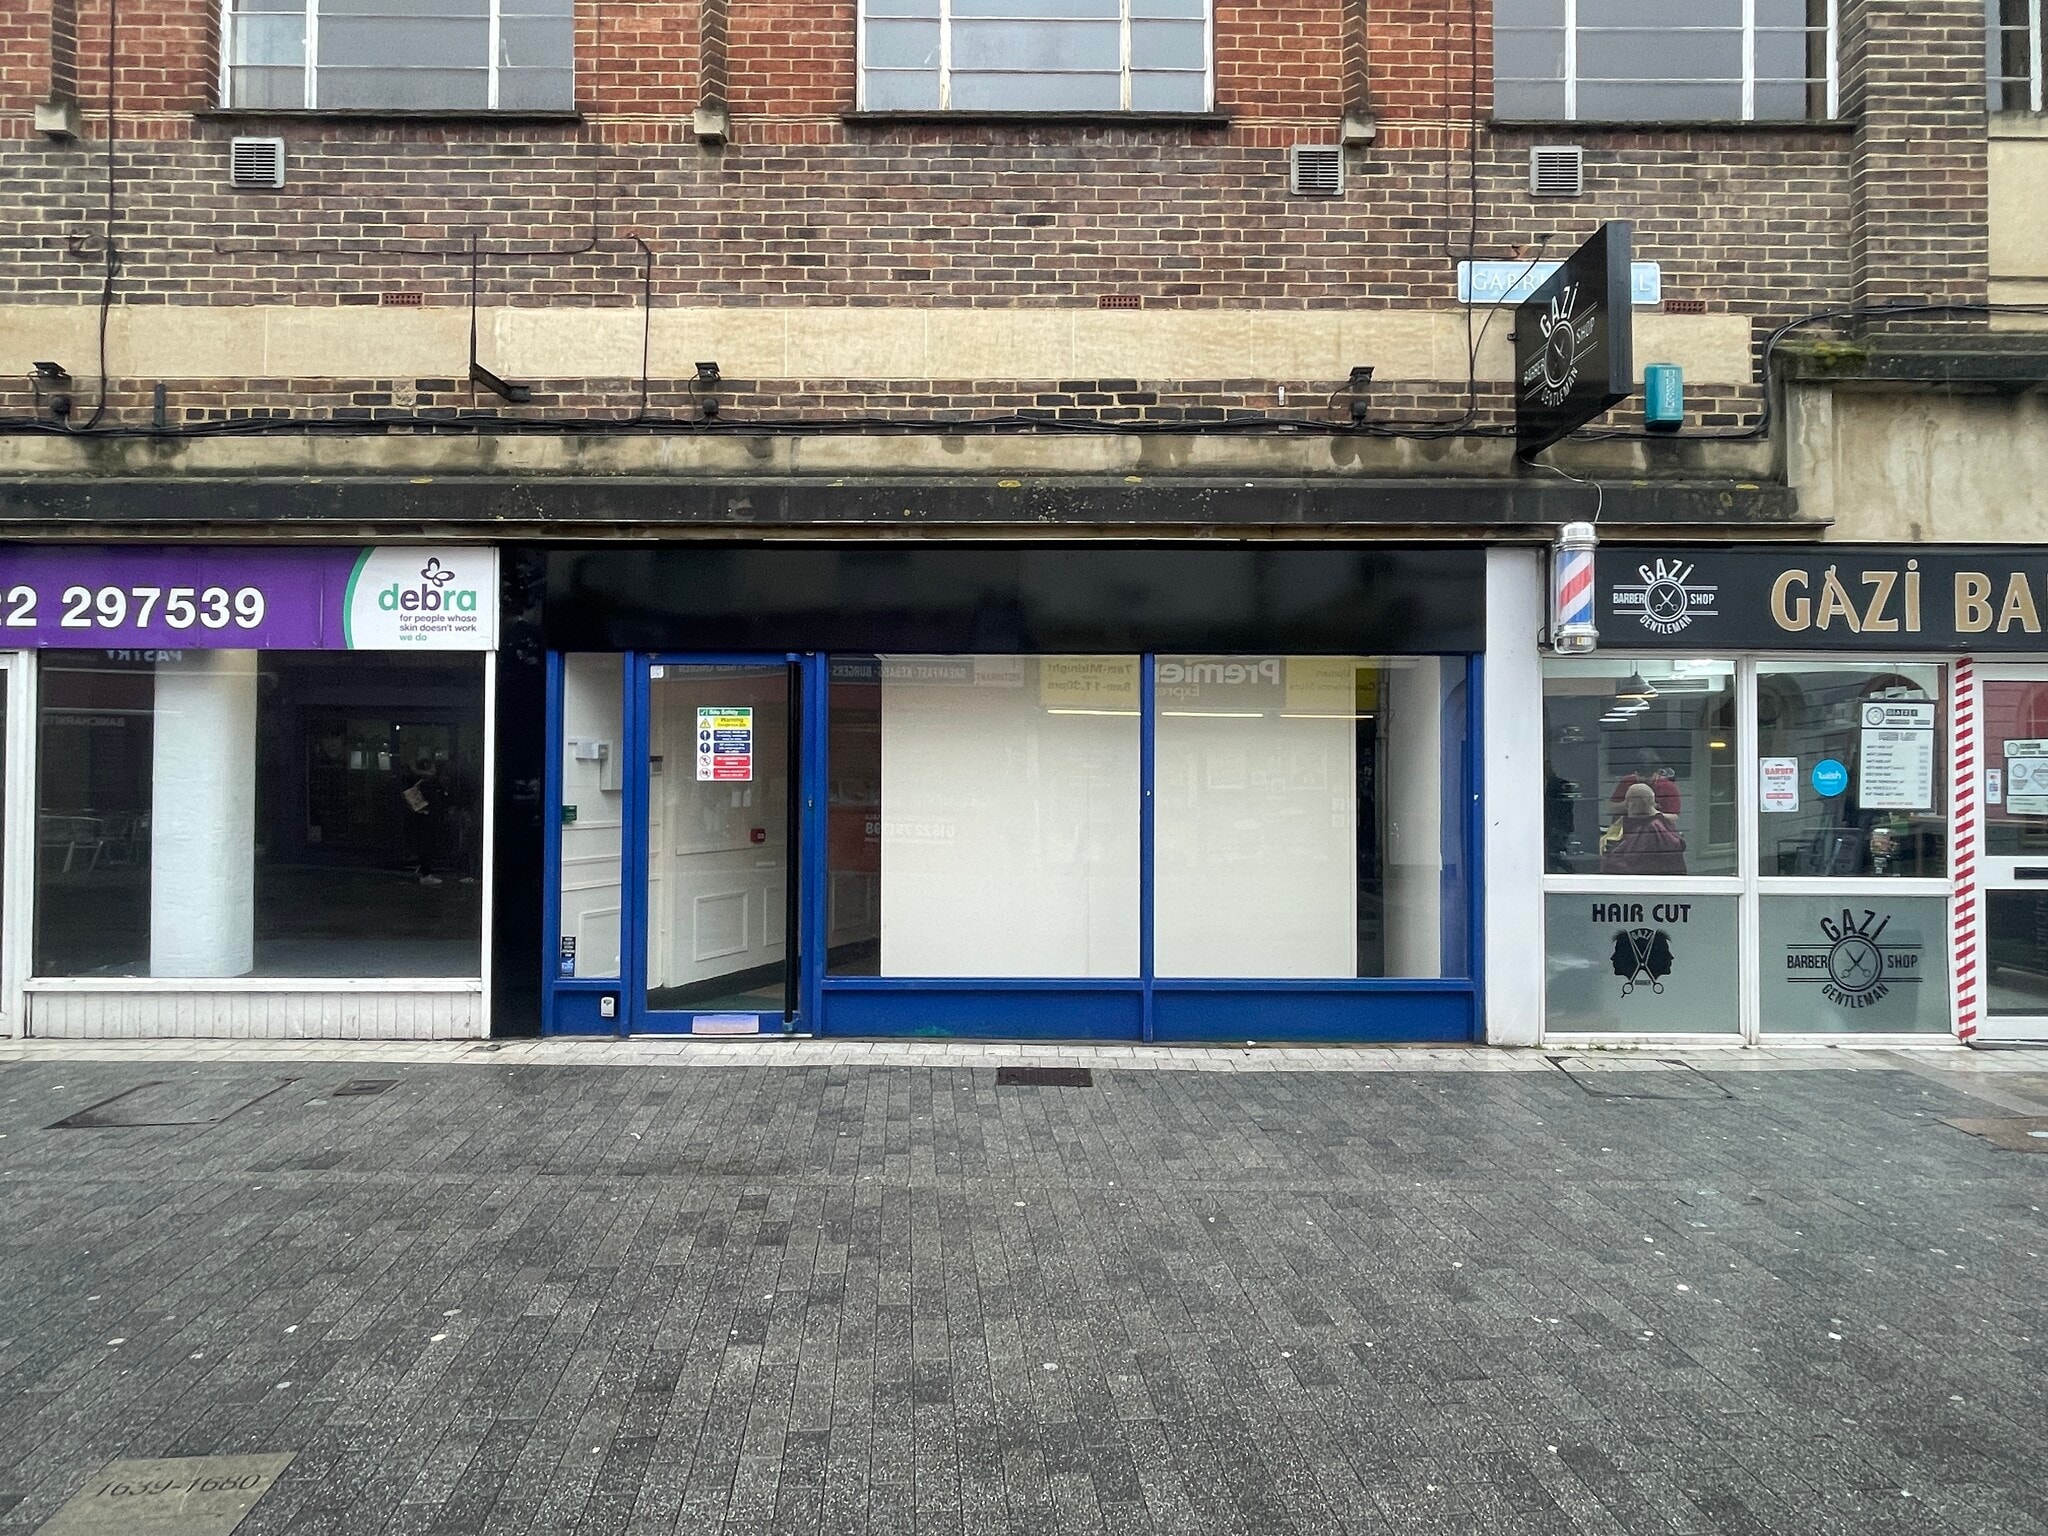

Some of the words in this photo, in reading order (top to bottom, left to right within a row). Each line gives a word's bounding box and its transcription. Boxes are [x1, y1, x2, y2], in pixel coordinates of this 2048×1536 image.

[1576, 317, 1596, 344] SHOP
[1540, 366, 1578, 408] GENTLEMAN
[0, 585, 37, 628] 2
[60, 586, 265, 629] 297539
[378, 583, 477, 611] debra
[1613, 592, 1645, 604] BARBER
[1690, 593, 1715, 605] SHOP
[1955, 572, 2048, 633] BA
[400, 614, 412, 622] for
[414, 614, 446, 623] people
[447, 614, 477, 622] whose
[400, 624, 418, 632] skin
[420, 624, 453, 632] doesn't
[454, 624, 477, 632] work
[1640, 614, 1693, 634] GENTLEMAN
[415, 633, 427, 641] do
[1592, 903, 1644, 922] HAIR
[1652, 904, 1691, 923] CUT
[1787, 954, 1828, 969] BARBER
[1887, 954, 1918, 969] SHOP
[1821, 983, 1890, 1009] GENTLEMAN
[96, 1474, 261, 1497] 1639-1680
